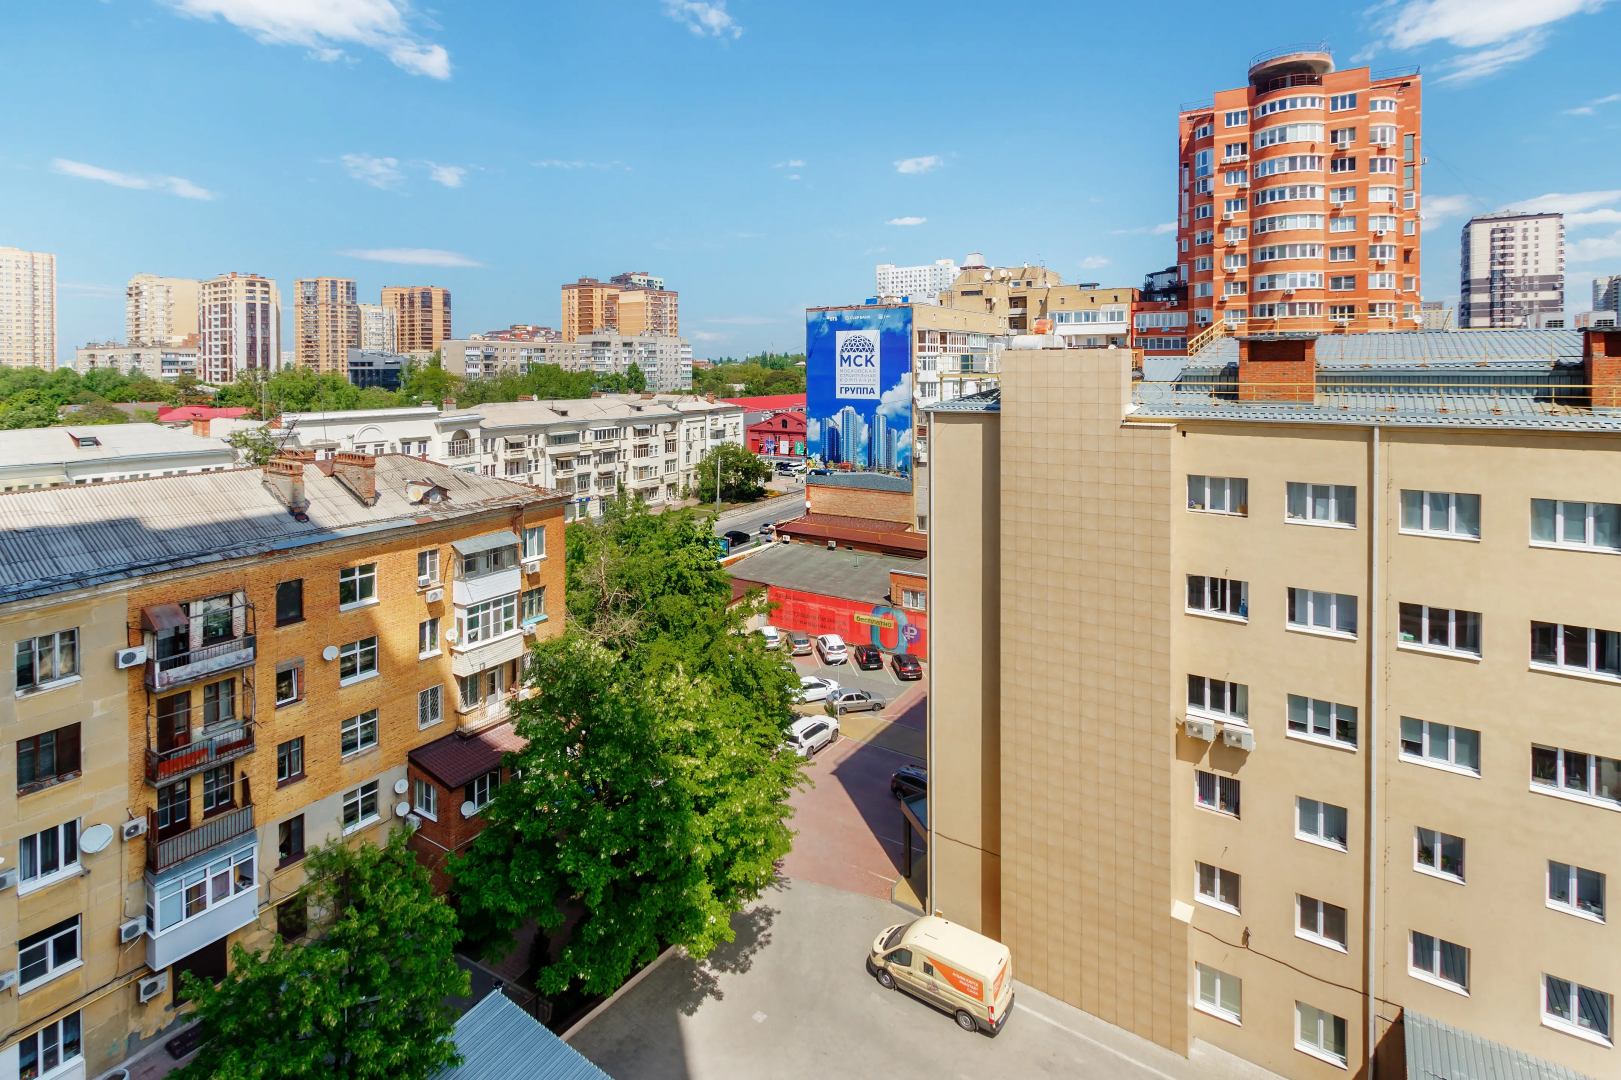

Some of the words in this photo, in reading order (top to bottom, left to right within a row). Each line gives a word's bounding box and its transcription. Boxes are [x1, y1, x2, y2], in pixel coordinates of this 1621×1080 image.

[840, 354, 875, 367] МСК
[839, 386, 876, 395] ГРУППА
[856, 615, 892, 628] бесплатно
